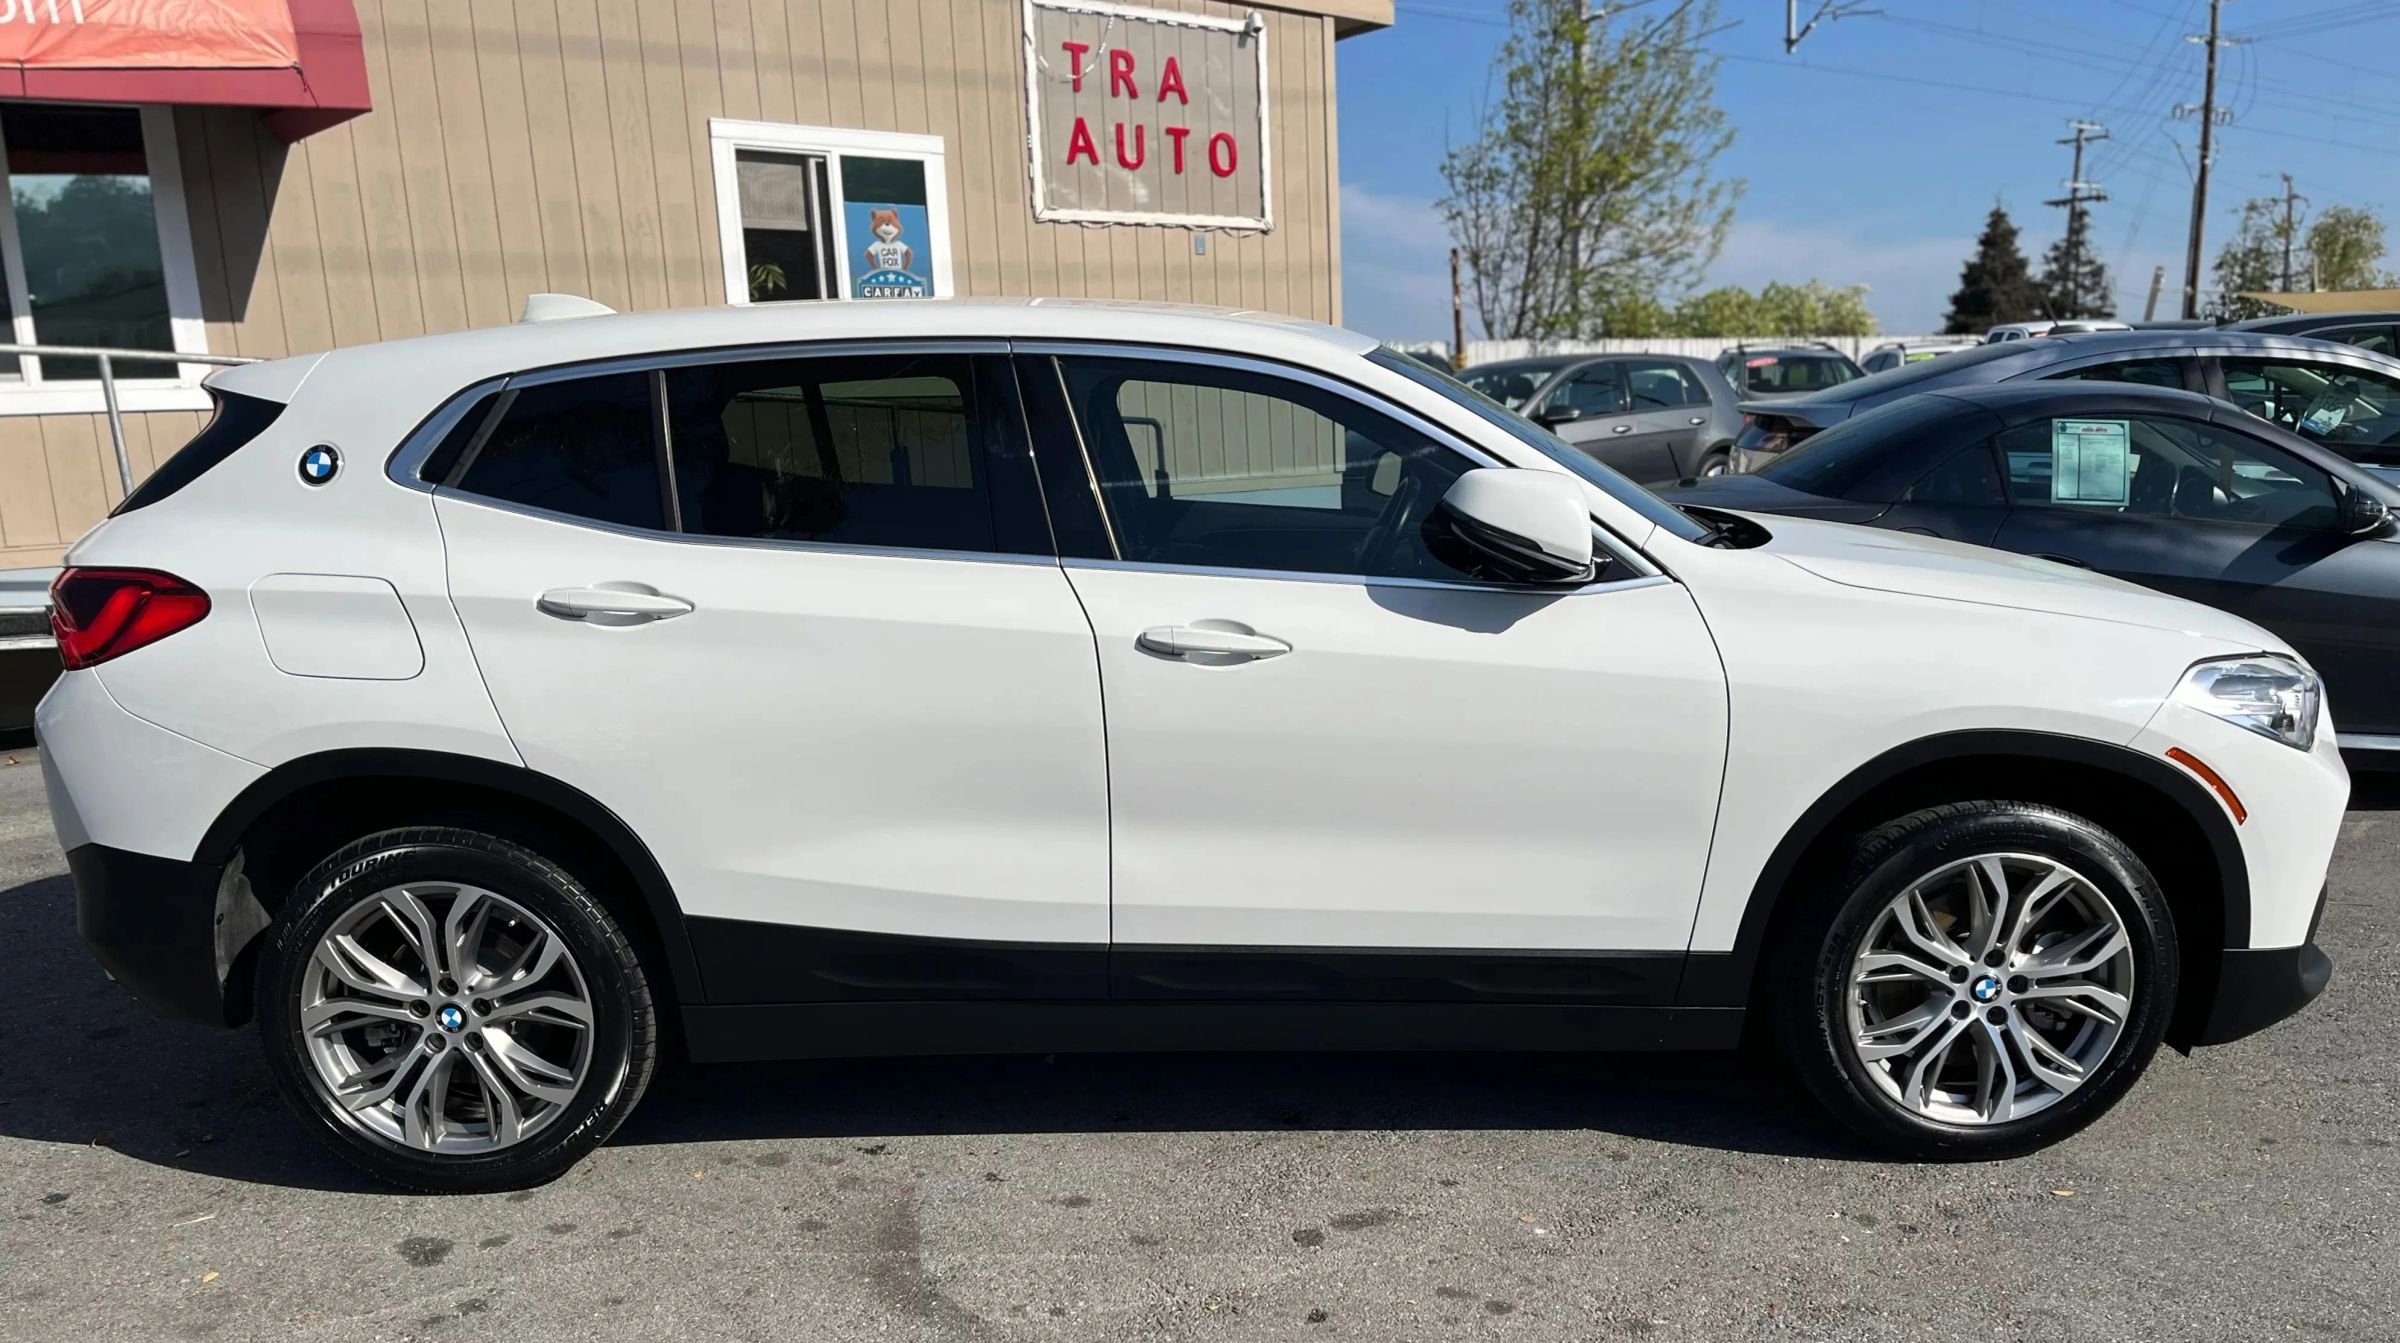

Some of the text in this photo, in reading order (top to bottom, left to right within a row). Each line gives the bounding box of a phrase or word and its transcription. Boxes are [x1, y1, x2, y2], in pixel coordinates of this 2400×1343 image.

[1062, 41, 1189, 105] TRA
[1067, 116, 1238, 178] AUTO
[881, 248, 898, 257] CAR
[882, 257, 899, 267] FOX
